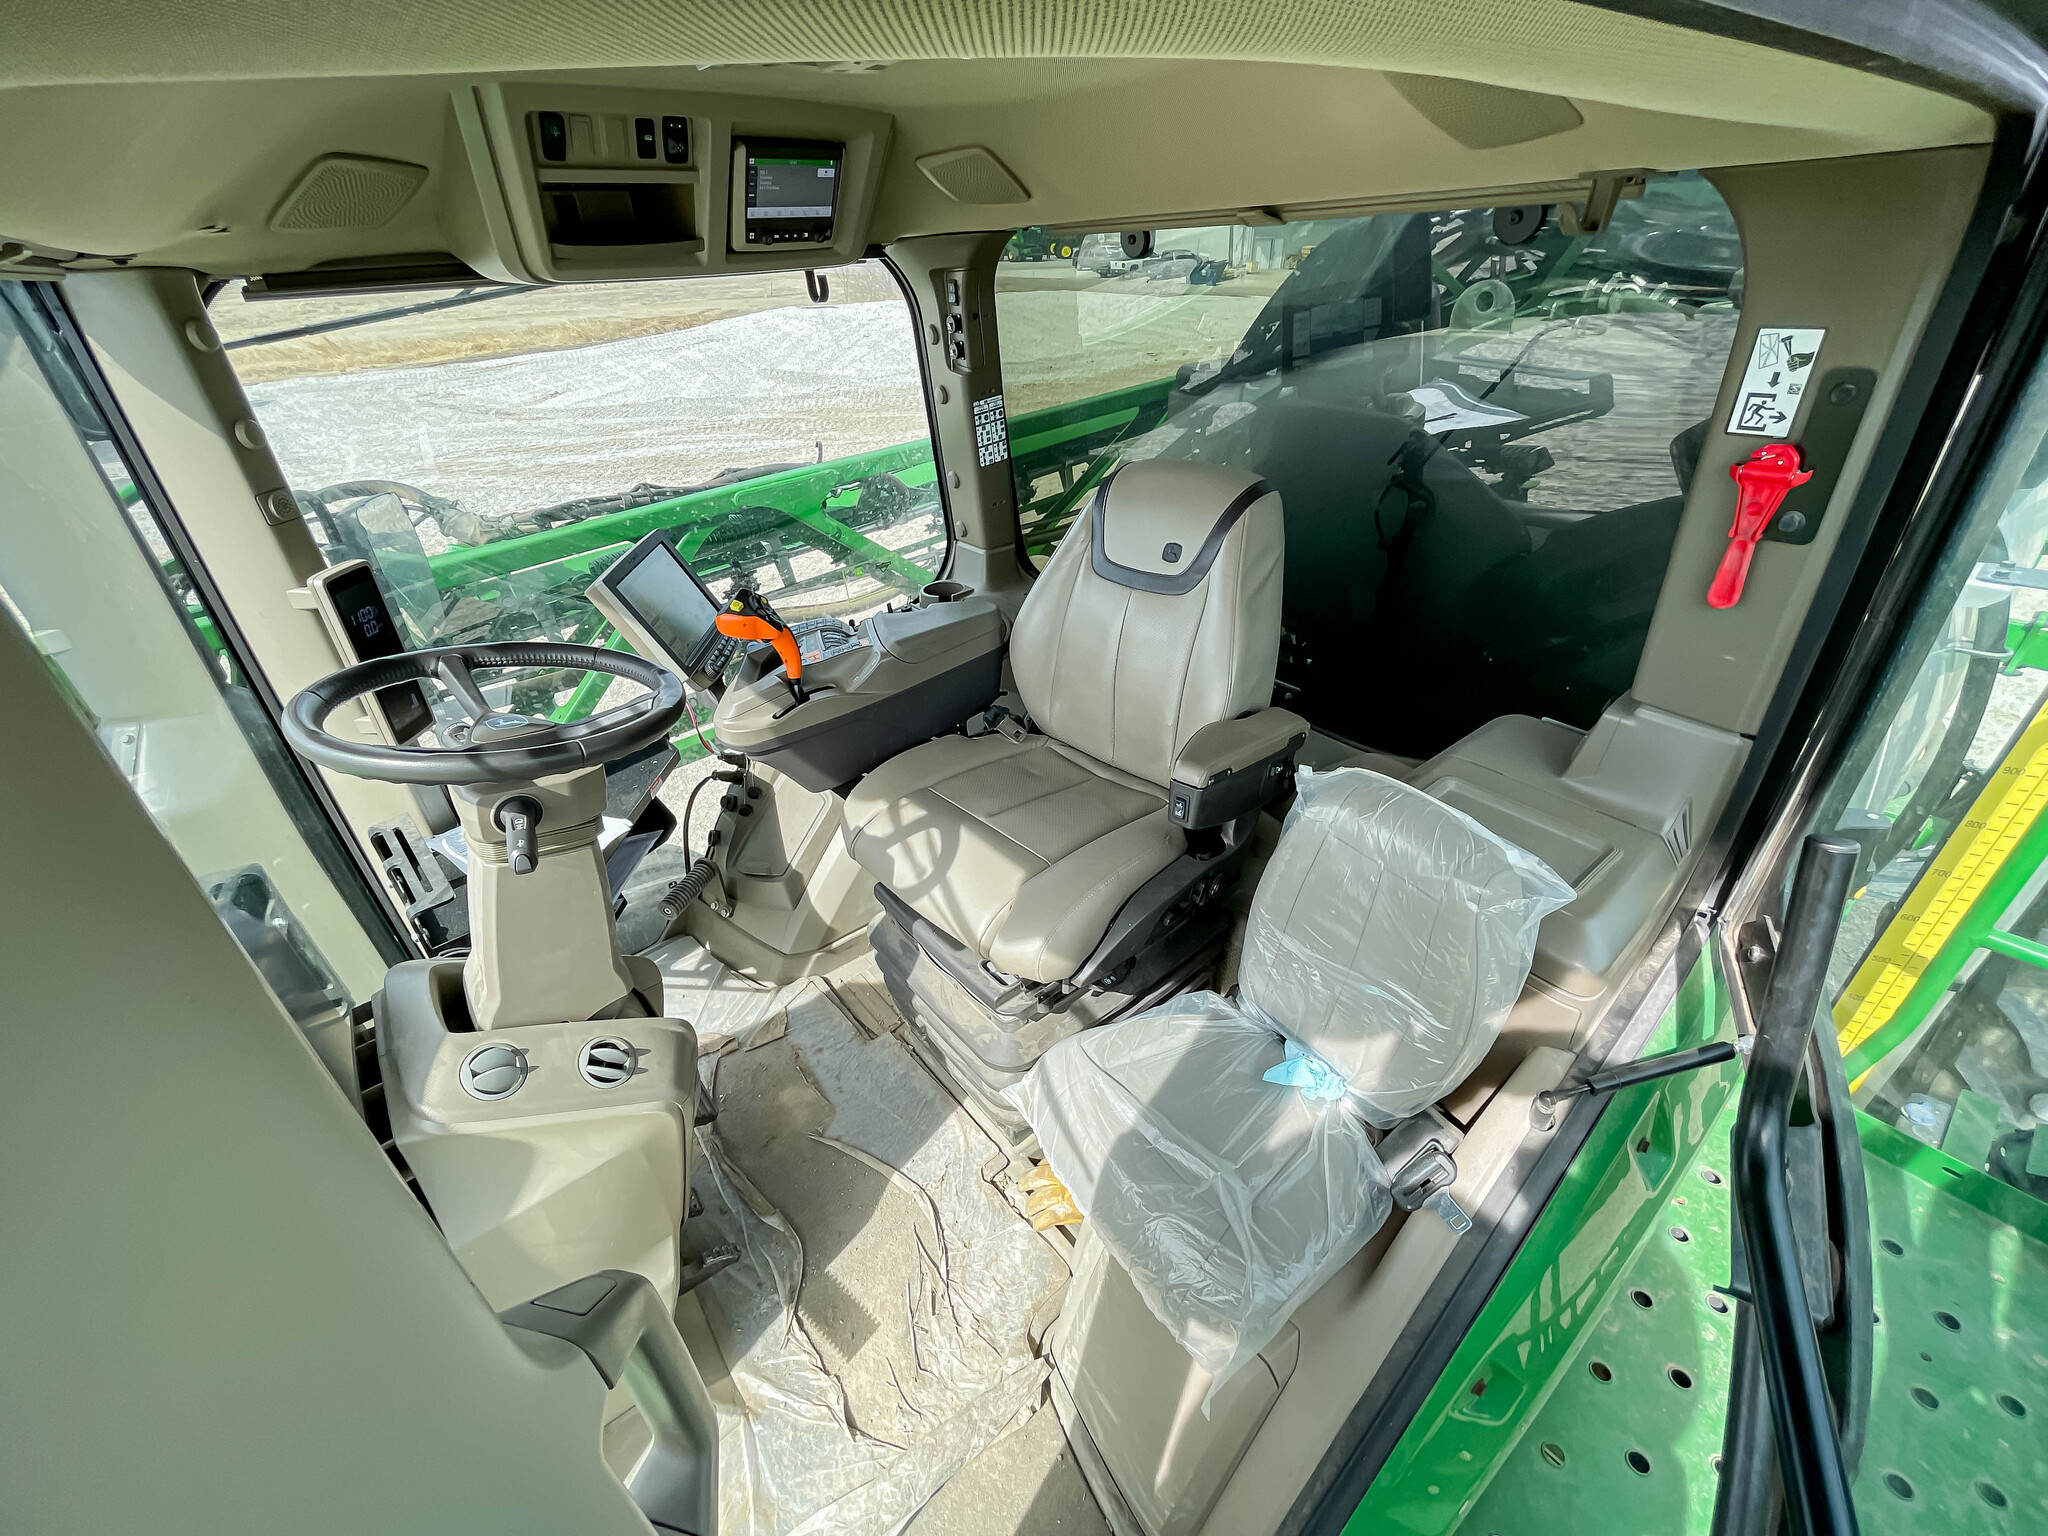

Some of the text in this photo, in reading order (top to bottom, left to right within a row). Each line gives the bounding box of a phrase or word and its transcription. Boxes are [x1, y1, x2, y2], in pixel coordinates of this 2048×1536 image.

[2002, 766, 2026, 776] 900
[1964, 819, 1987, 830] 800
[1932, 868, 1952, 878] 700
[1900, 913, 1920, 922] 600
[1871, 954, 1892, 964] 500
